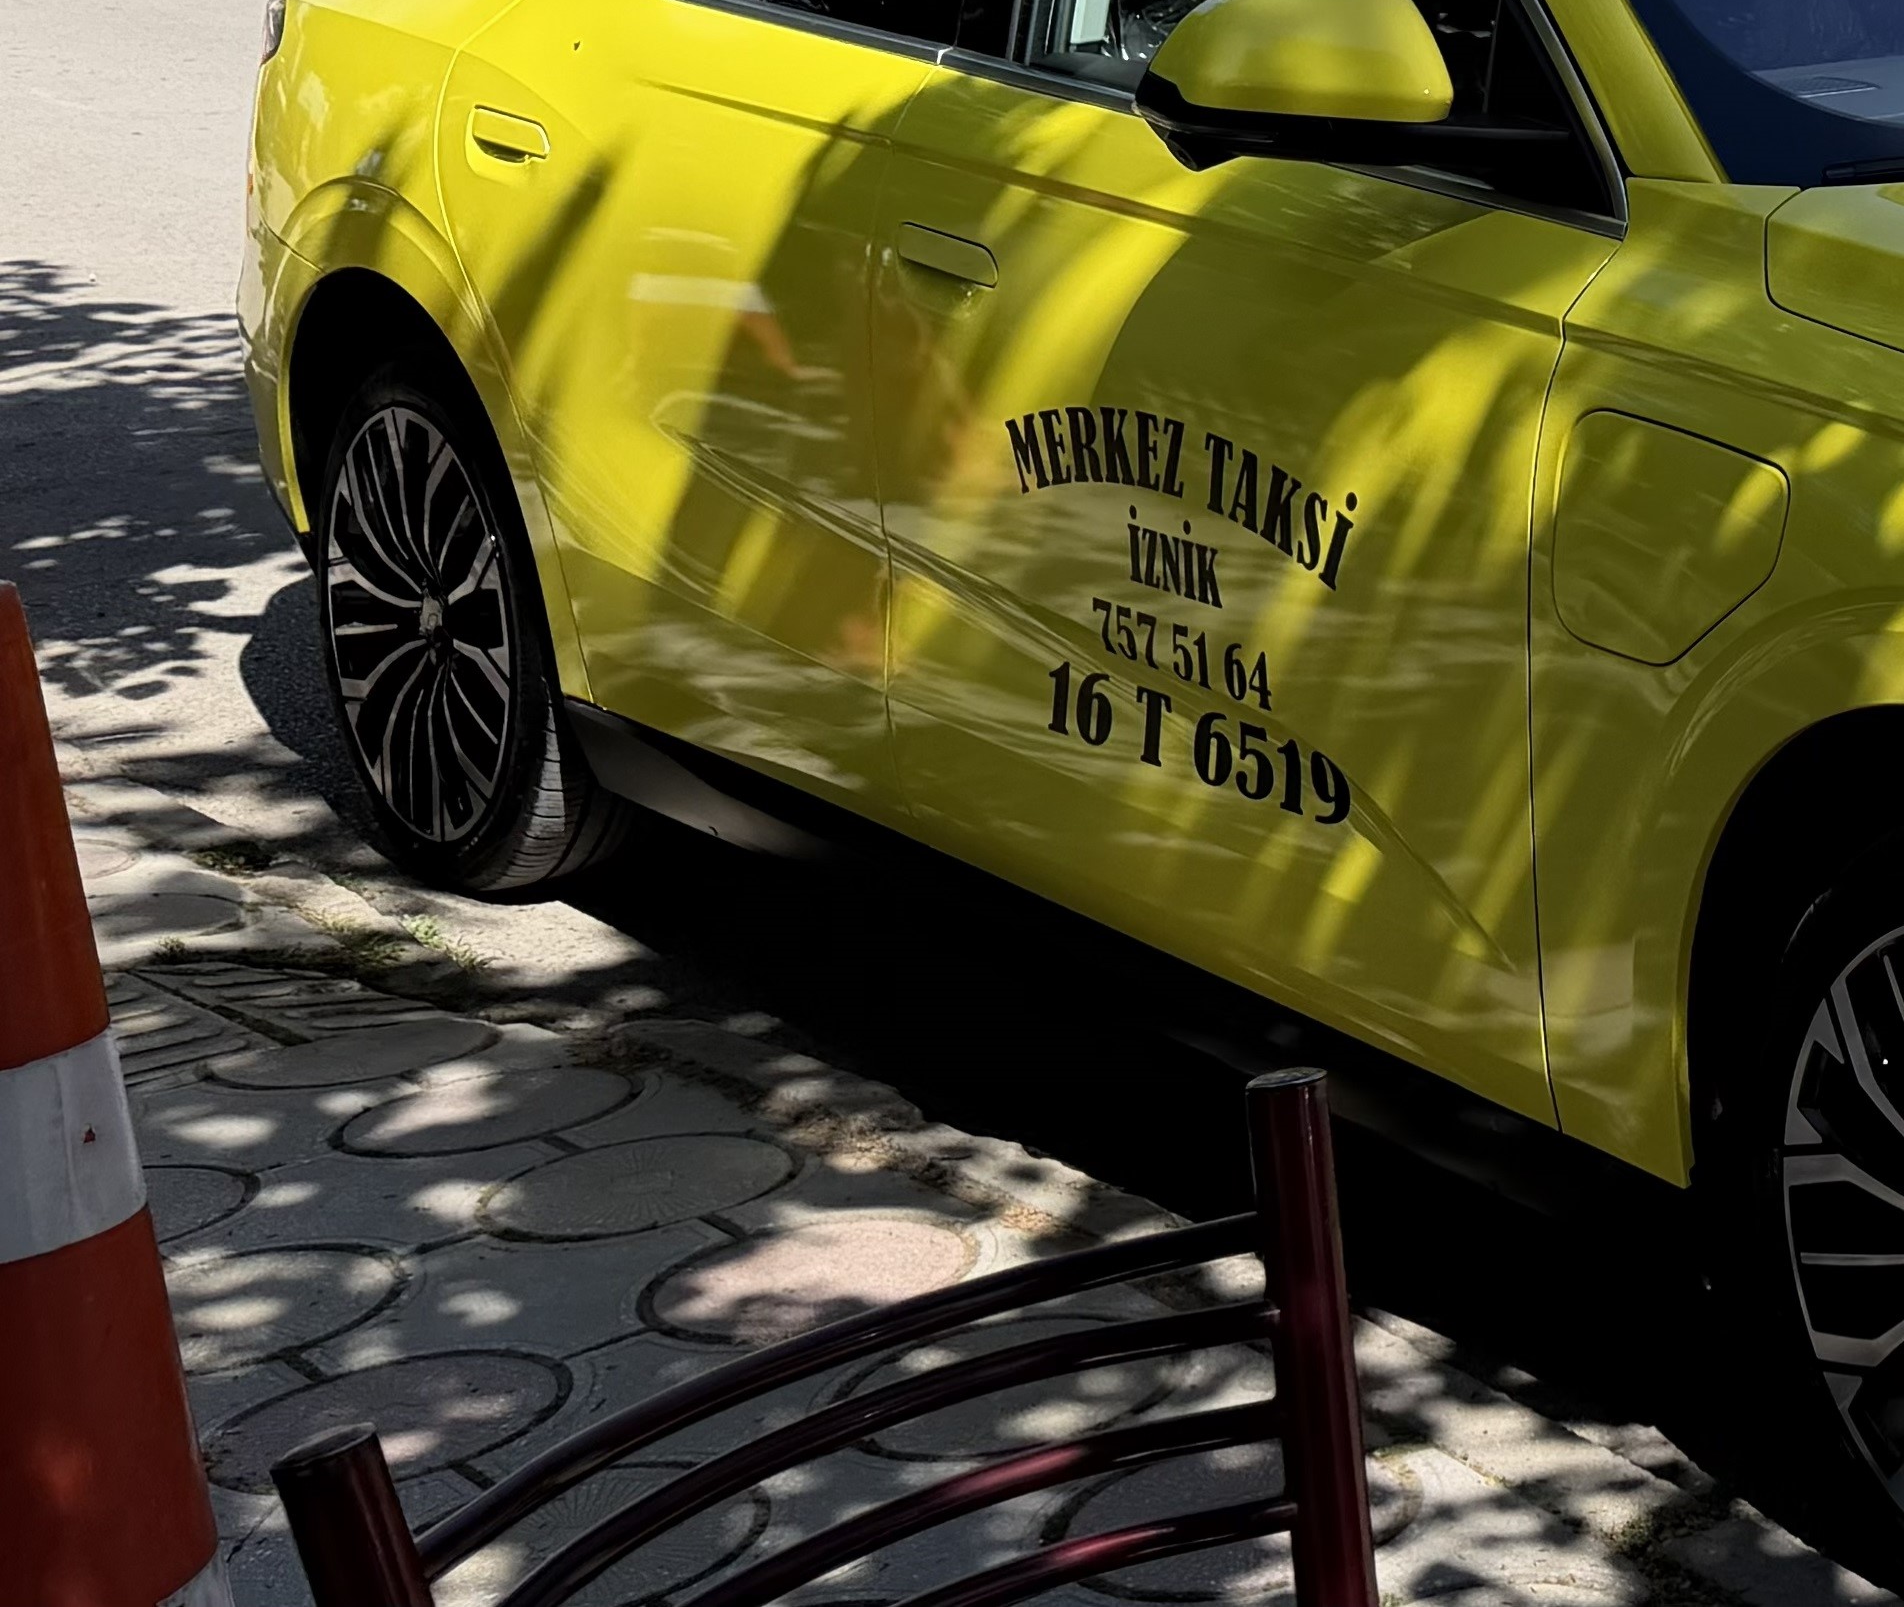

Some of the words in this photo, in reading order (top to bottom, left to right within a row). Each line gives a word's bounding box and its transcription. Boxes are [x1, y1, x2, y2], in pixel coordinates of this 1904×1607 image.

[1005, 406, 1185, 499] MERKEZ
[1204, 432, 1358, 591] TAKSİ
[1127, 505, 1223, 609] İZNİK
[1092, 597, 1159, 670] 757
[1173, 623, 1212, 690] 51
[1224, 643, 1273, 713] 64
[1048, 661, 1112, 746] 16
[1136, 685, 1172, 767] T
[1194, 712, 1351, 825] 6519
